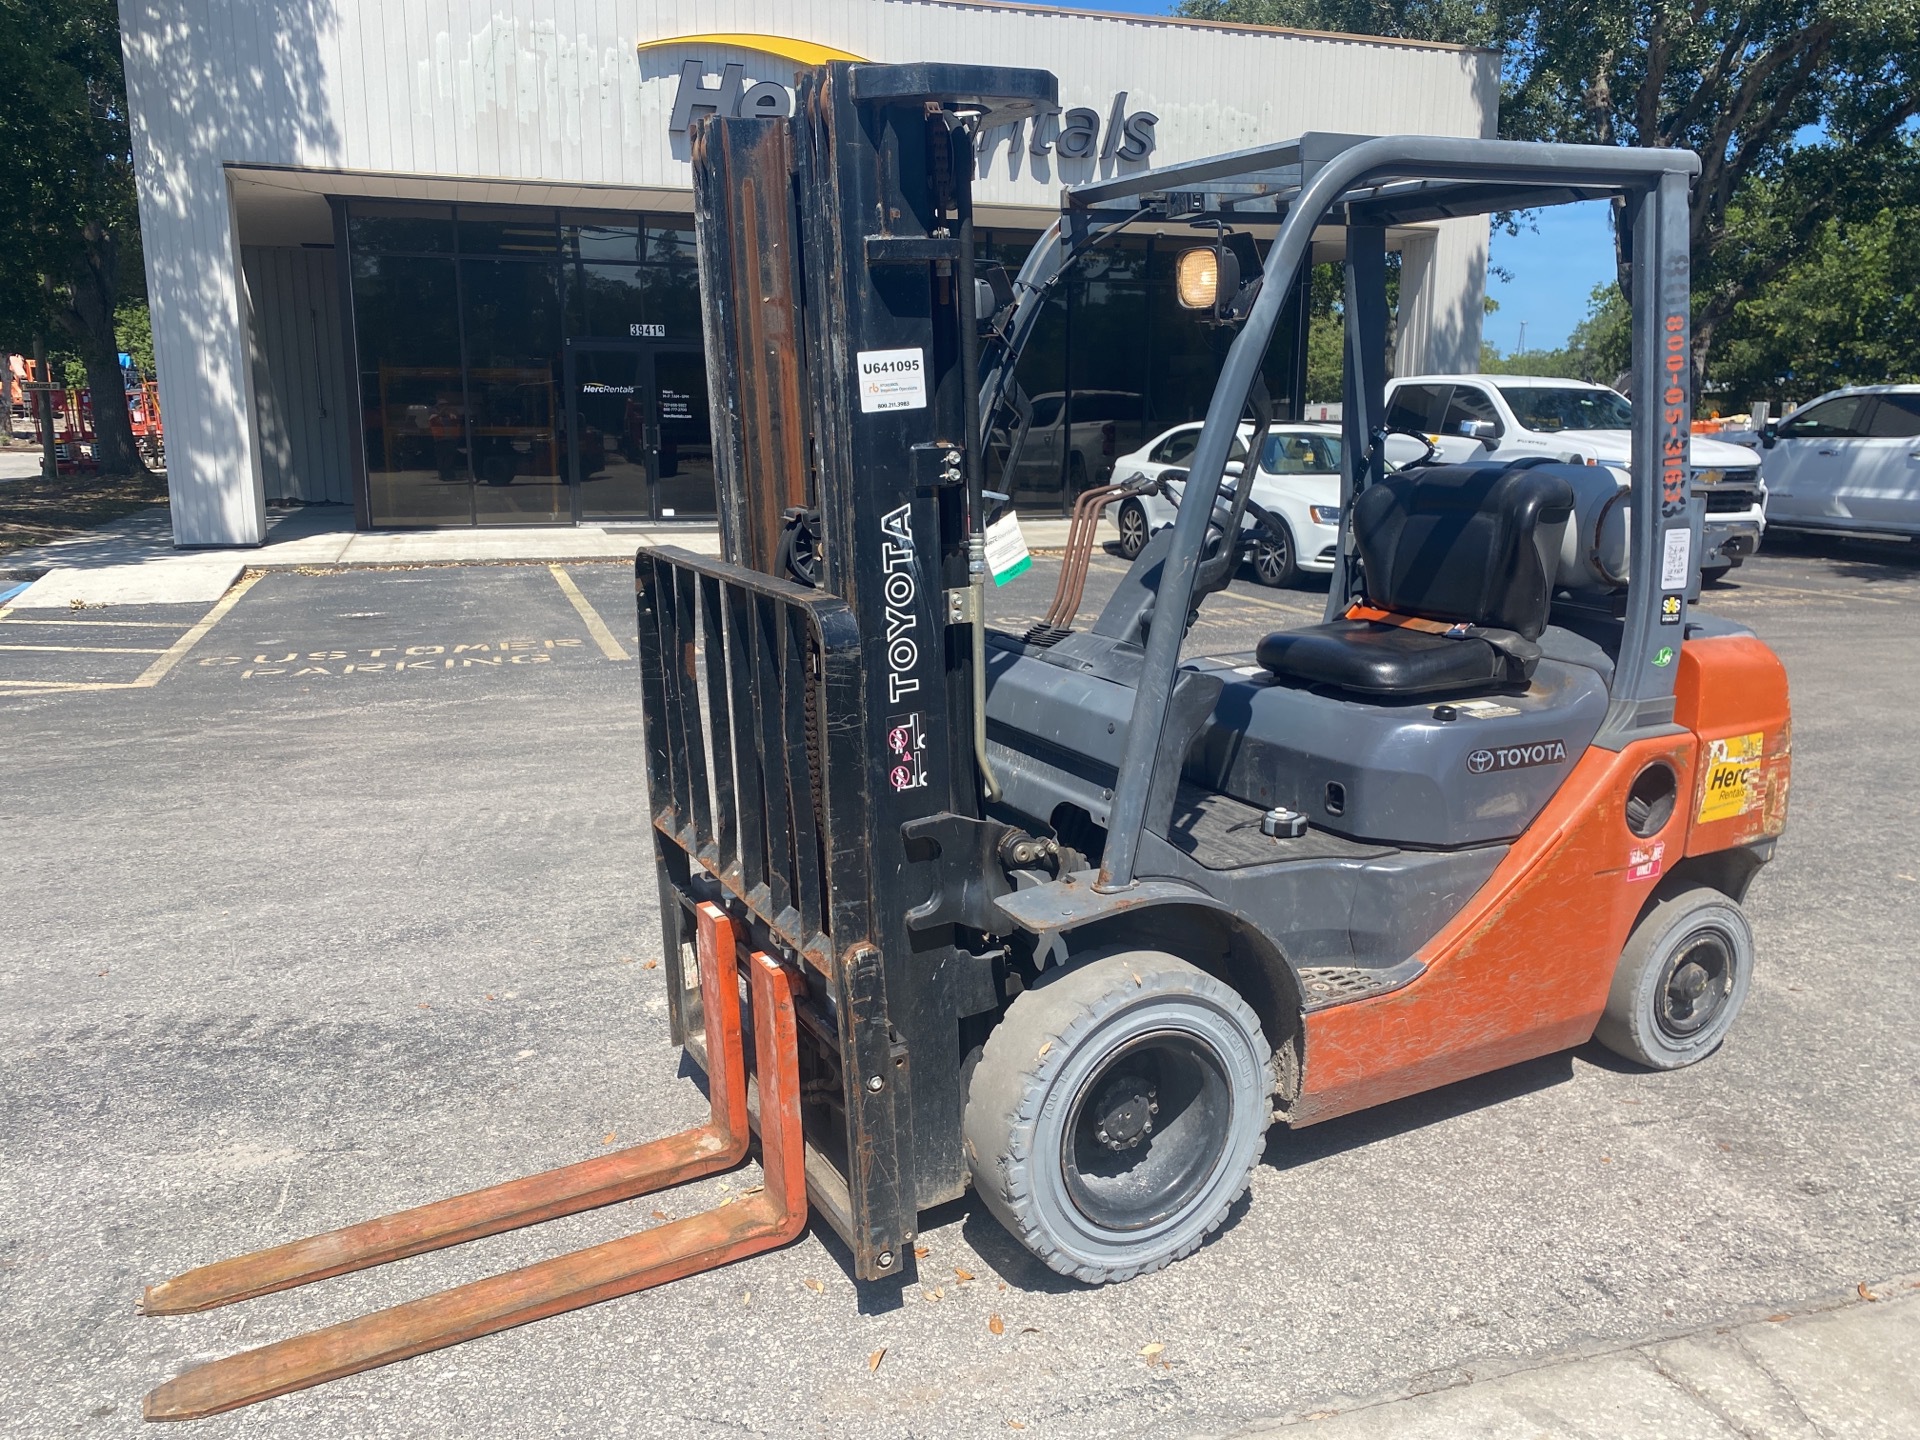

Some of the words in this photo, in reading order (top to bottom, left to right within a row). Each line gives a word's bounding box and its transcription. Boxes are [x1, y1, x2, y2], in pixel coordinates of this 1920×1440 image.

[630, 324, 665, 336] 39418
[863, 360, 919, 374] U641095
[583, 385, 634, 393] HercRentals
[881, 502, 920, 704] TOYOTA
[198, 638, 583, 666] CUSTOMER
[240, 653, 552, 680] PARKING
[1497, 743, 1566, 767] TOYOTA
[1710, 767, 1750, 791] Herc
